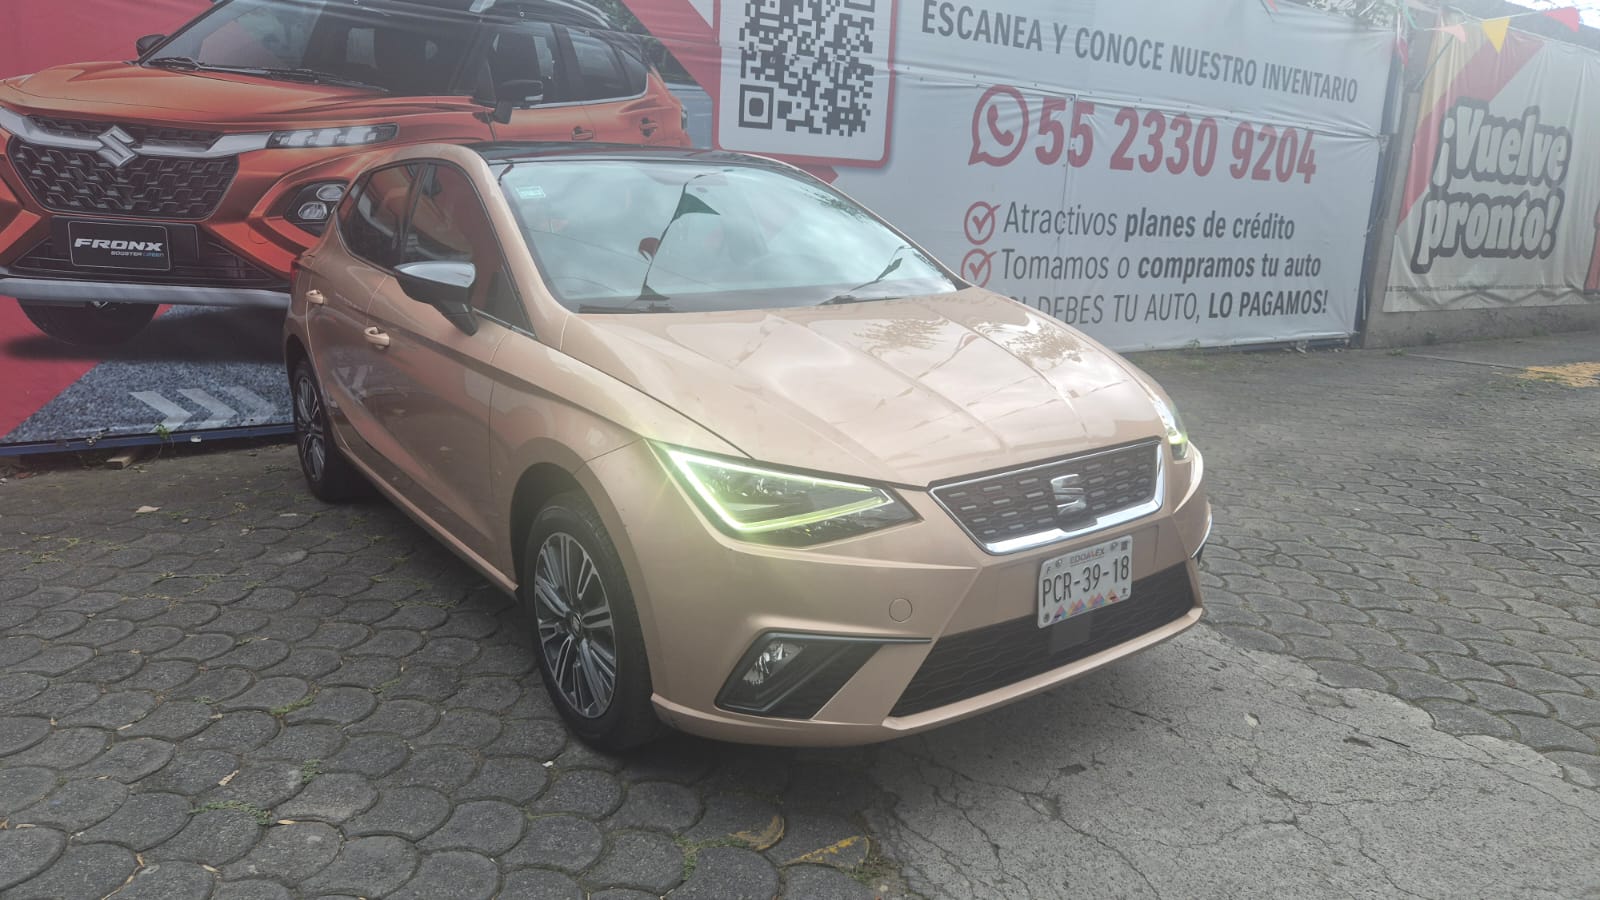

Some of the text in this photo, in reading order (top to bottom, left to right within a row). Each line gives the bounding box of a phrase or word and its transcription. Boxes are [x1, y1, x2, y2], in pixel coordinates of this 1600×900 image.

[921, 0, 1358, 104] ESCANEA Y CONOCE NUESTRO INVENTARIO
[1035, 96, 1317, 184] 55 2330 9204
[1430, 99, 1570, 190] ¡Vuelve
[74, 238, 163, 251] FRONX
[1003, 201, 1295, 242] Atractivos planes de crédito
[1411, 186, 1565, 274] pronto!
[1002, 248, 1321, 284] Tomamos o compramos tu auto
[1038, 289, 1328, 324] DEBES TU AUTO, LO PAGAMOS!
[1042, 555, 1129, 608] PCR-39-18
